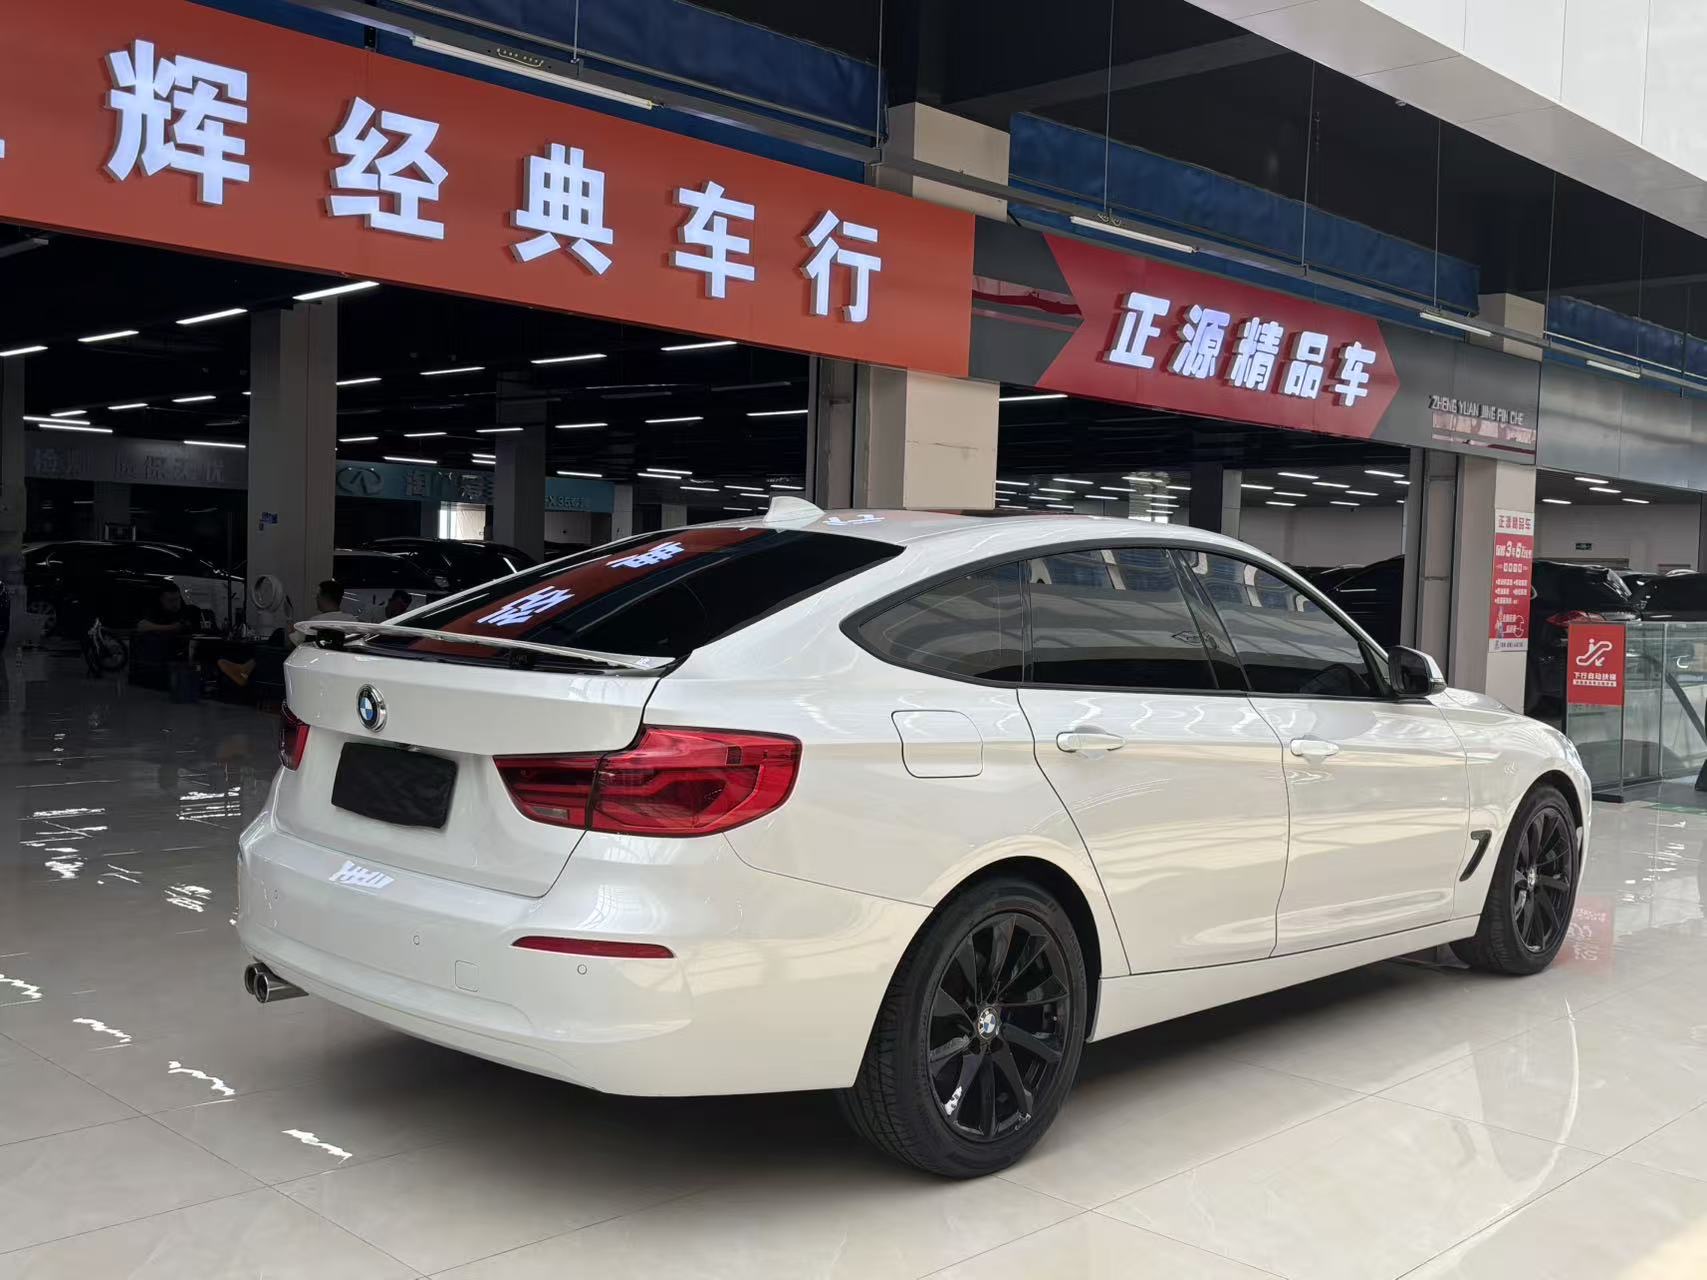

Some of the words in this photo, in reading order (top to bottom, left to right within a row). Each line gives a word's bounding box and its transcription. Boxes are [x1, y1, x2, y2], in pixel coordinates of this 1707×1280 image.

[0, 39, 882, 323] 辉经典车行
[1107, 291, 1376, 407] 正源精品车
[1431, 395, 1457, 413] ZHENG
[1459, 400, 1479, 417] YUAN
[1510, 411, 1525, 425] CHE
[1573, 671, 1617, 681] 下行自动扶梯
